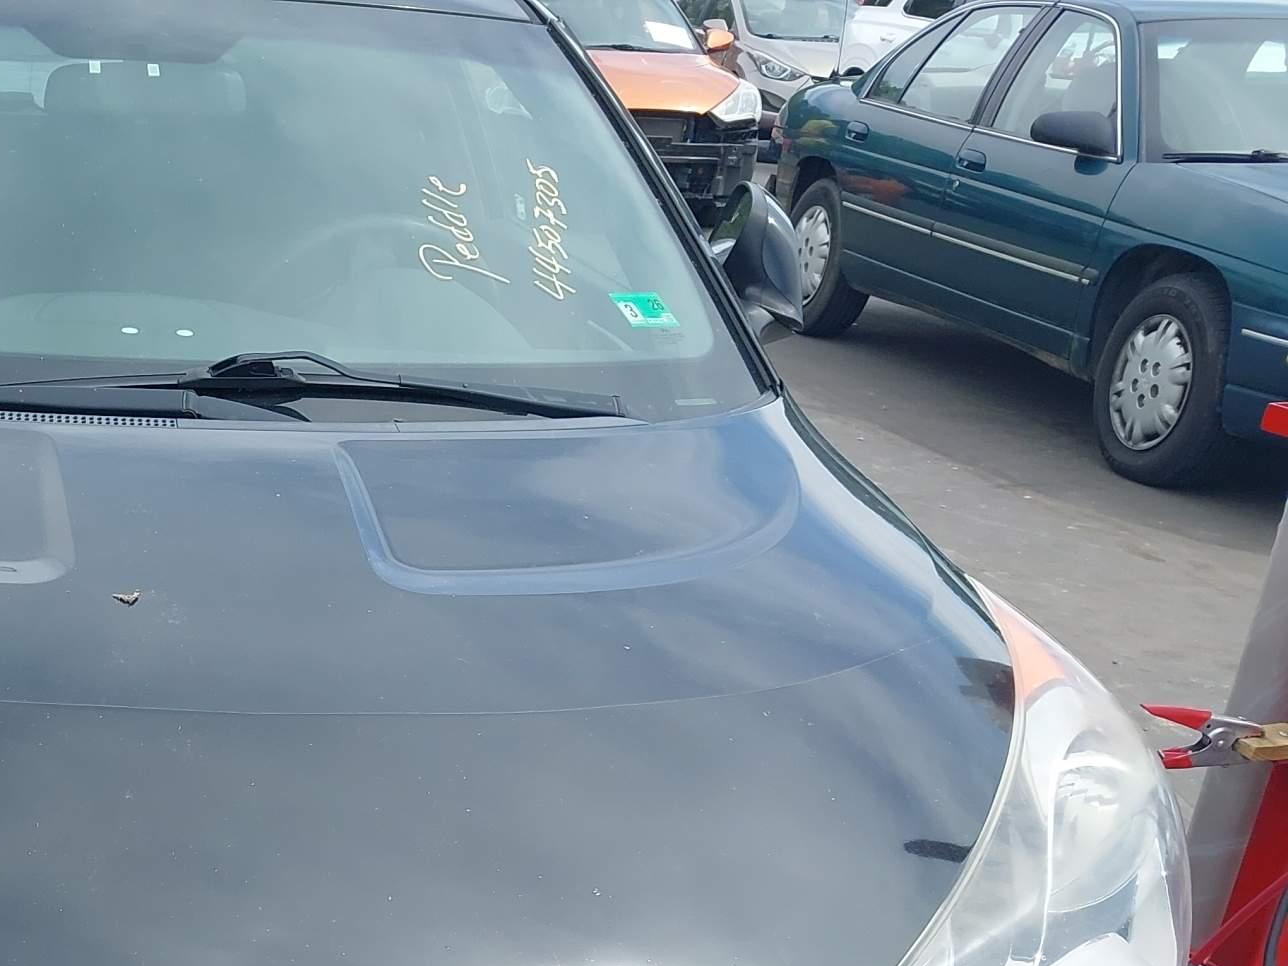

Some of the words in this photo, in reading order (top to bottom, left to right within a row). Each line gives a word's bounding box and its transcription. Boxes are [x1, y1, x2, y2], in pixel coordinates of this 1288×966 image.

[418, 175, 511, 284] Peddle
[525, 157, 577, 300] 44507305
[623, 303, 638, 318] 3
